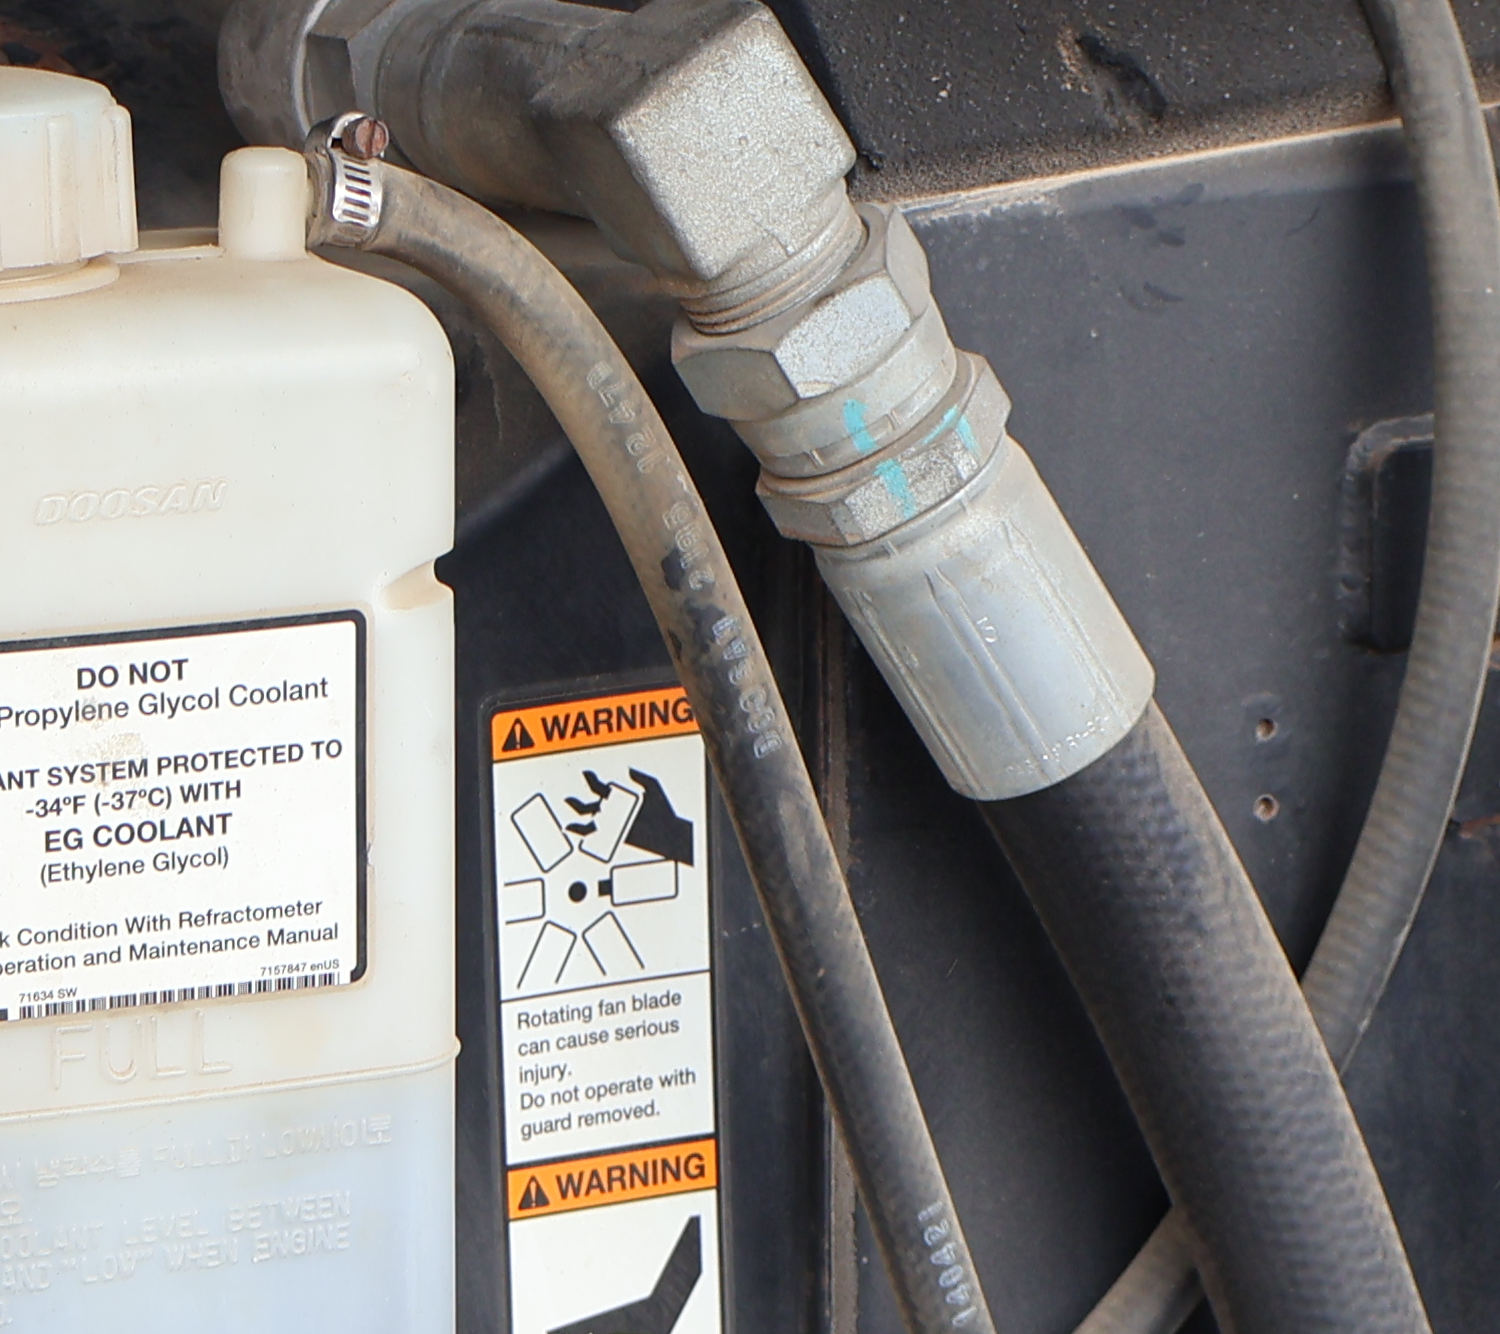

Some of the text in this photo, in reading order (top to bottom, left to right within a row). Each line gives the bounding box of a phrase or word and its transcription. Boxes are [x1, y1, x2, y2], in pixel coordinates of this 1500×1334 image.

[34, 476, 228, 526] DOOSAN
[78, 659, 188, 689] DO NOT
[139, 688, 218, 718] Glycol
[230, 678, 327, 706] Coolant
[541, 698, 695, 742] WARNING
[48, 759, 147, 785] SYSTEM
[158, 744, 303, 775] PROTECTED
[312, 740, 342, 759] TO
[180, 780, 240, 803] WITH
[46, 813, 232, 852] EG COOLANT
[41, 847, 228, 886] (Ethylene Glycol)
[18, 924, 117, 945] Condition
[126, 915, 170, 933] With
[180, 902, 321, 928] Refractometer
[84, 947, 120, 965] and
[130, 936, 259, 960] Maintenance
[268, 924, 337, 945] Manual
[311, 960, 338, 970] enUS
[58, 989, 76, 998] SW
[517, 990, 682, 1030] Rotating fan blade
[53, 1011, 234, 1091] FULL
[518, 1019, 680, 1056] can cause serious
[519, 1063, 572, 1085] injury.
[520, 1068, 696, 1110] Do not operate with
[521, 1100, 660, 1141] guard removed.
[556, 1153, 705, 1200] WARNING
[125, 1210, 209, 1245] LEVEL
[225, 1189, 351, 1232] BETWEEN
[1, 1262, 52, 1293] AND
[165, 1237, 238, 1273] WHEN
[251, 1221, 350, 1264] ENGINE
